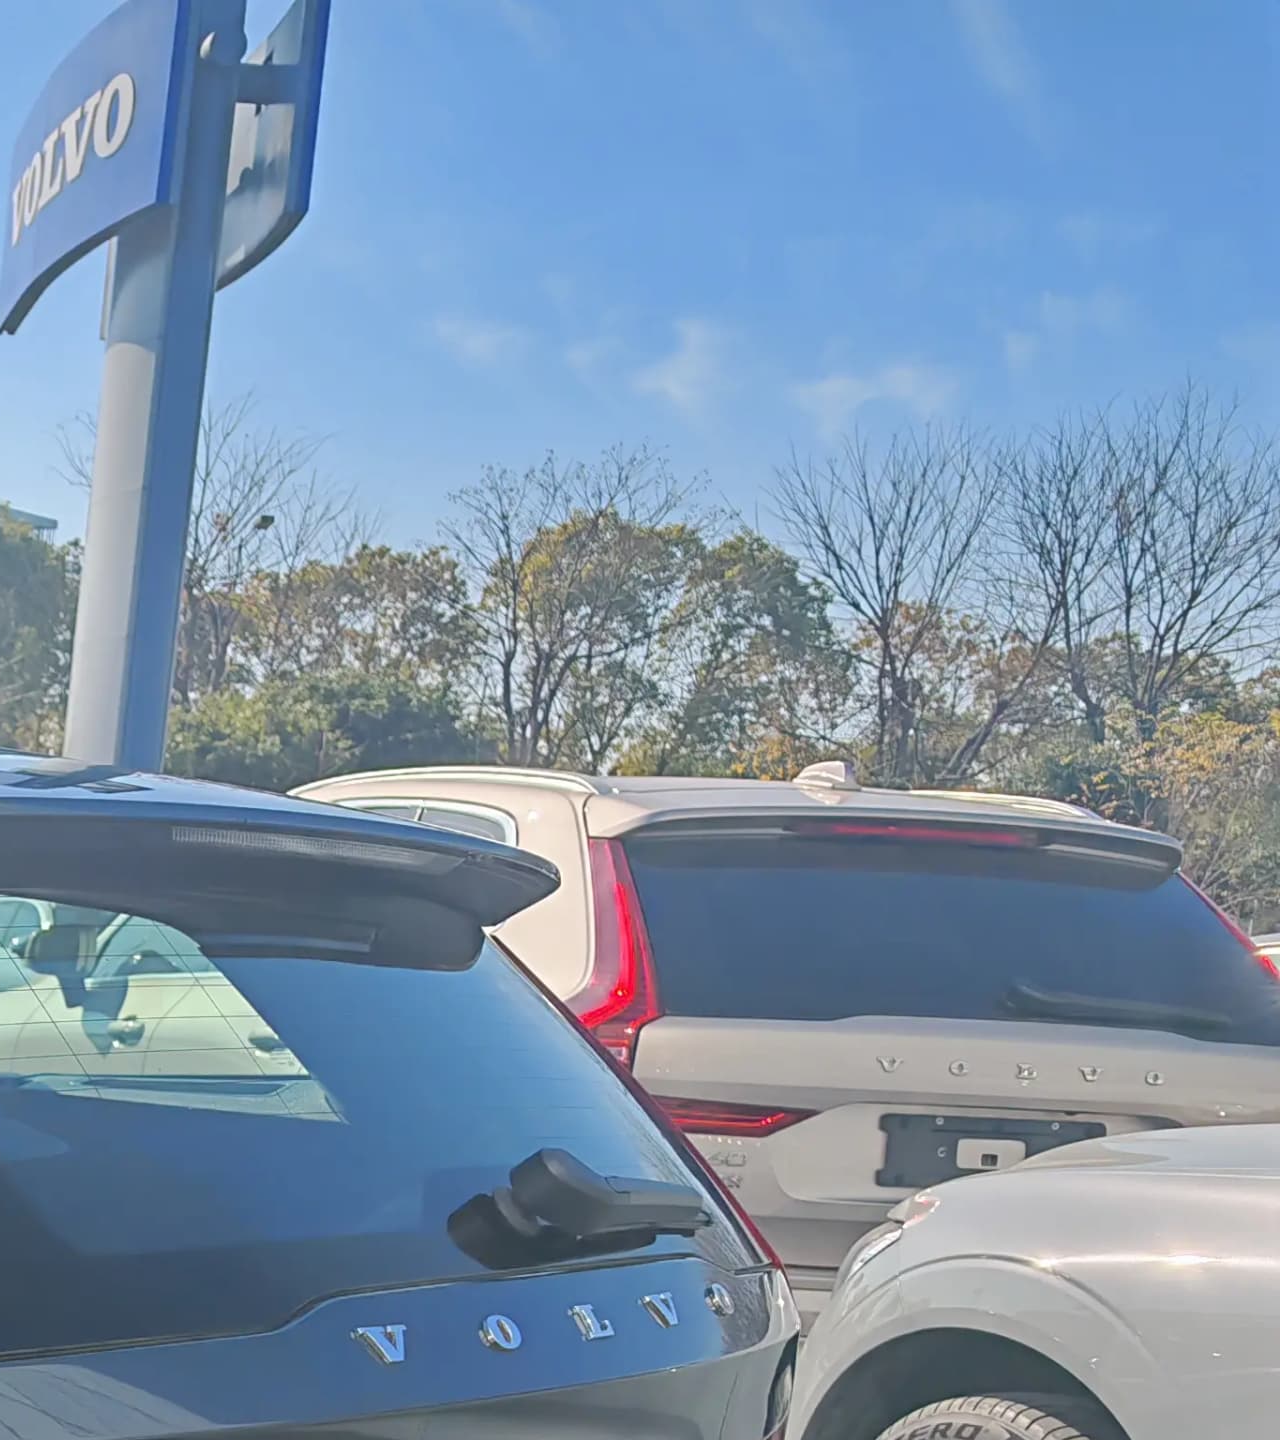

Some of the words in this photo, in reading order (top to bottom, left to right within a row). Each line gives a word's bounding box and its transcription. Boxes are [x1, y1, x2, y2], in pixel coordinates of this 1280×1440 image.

[11, 72, 136, 248] VOLVO
[876, 1055, 1166, 1087] VOLVO
[349, 1282, 736, 1366] VOLVO
